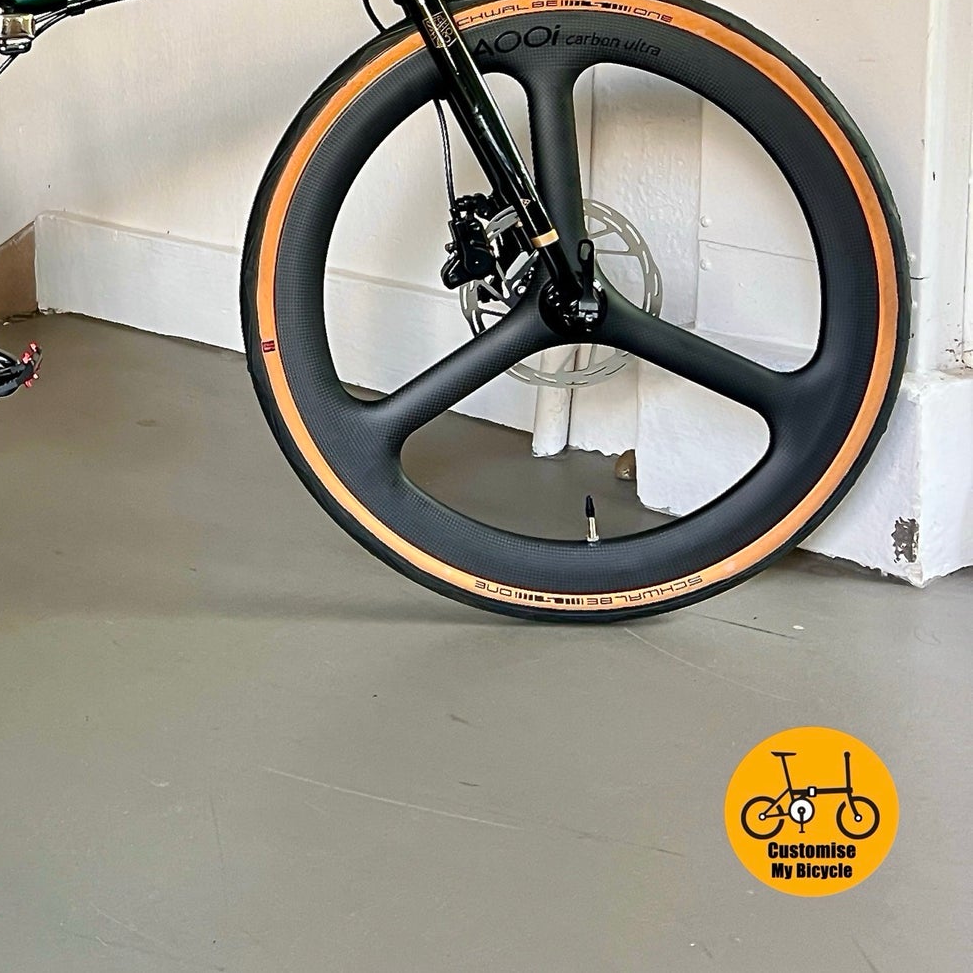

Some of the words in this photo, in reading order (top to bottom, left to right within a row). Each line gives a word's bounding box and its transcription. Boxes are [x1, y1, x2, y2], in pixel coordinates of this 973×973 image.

[457, 0, 558, 27] CHWALBE
[565, 31, 620, 49] carbon
[626, 38, 662, 57] ultra
[586, 574, 704, 606] SCHWALBE
